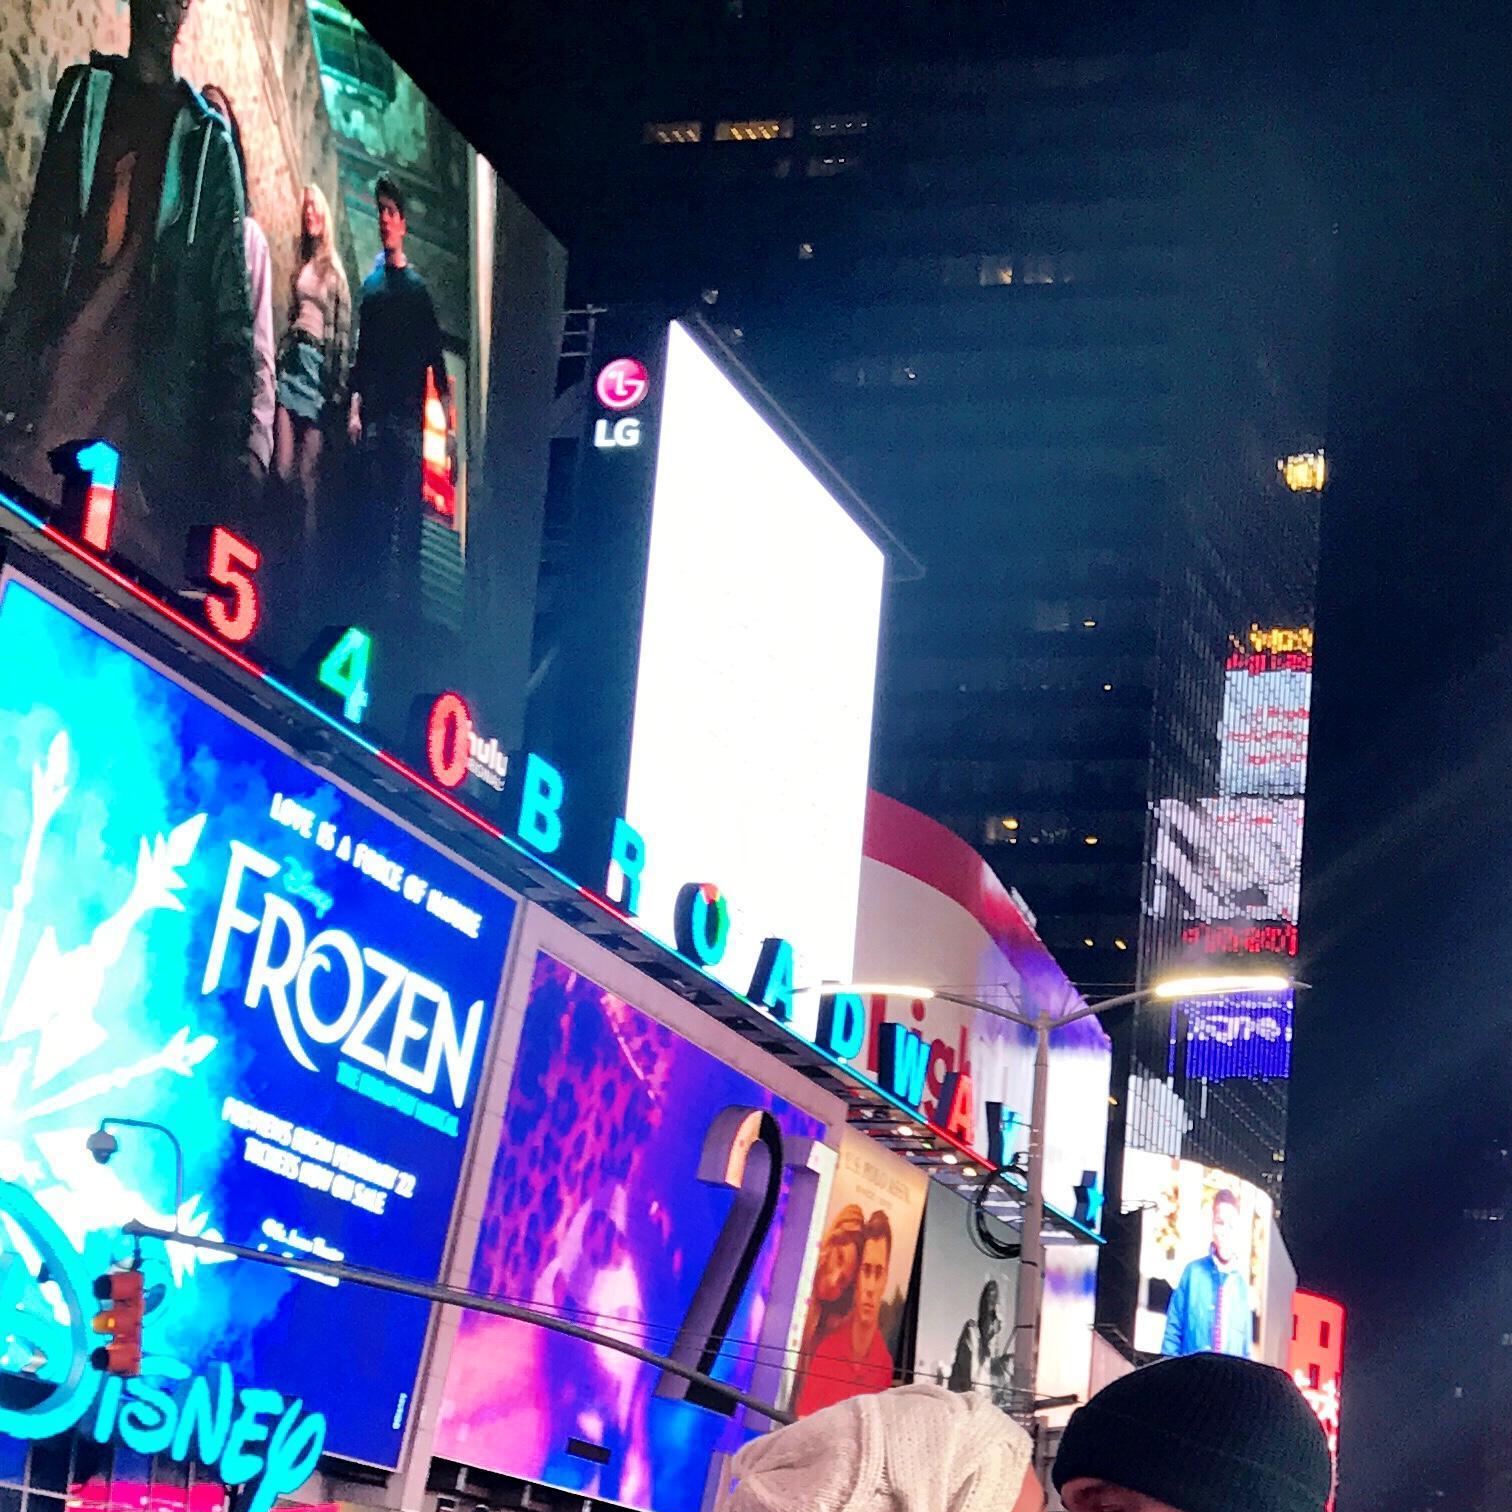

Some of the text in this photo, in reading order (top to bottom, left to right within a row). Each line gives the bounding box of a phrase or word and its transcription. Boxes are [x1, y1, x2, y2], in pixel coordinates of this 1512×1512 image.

[593, 418, 641, 448] LG
[76, 439, 1023, 1168] 1540 BROADWAY
[202, 840, 485, 1109] FROZEN
